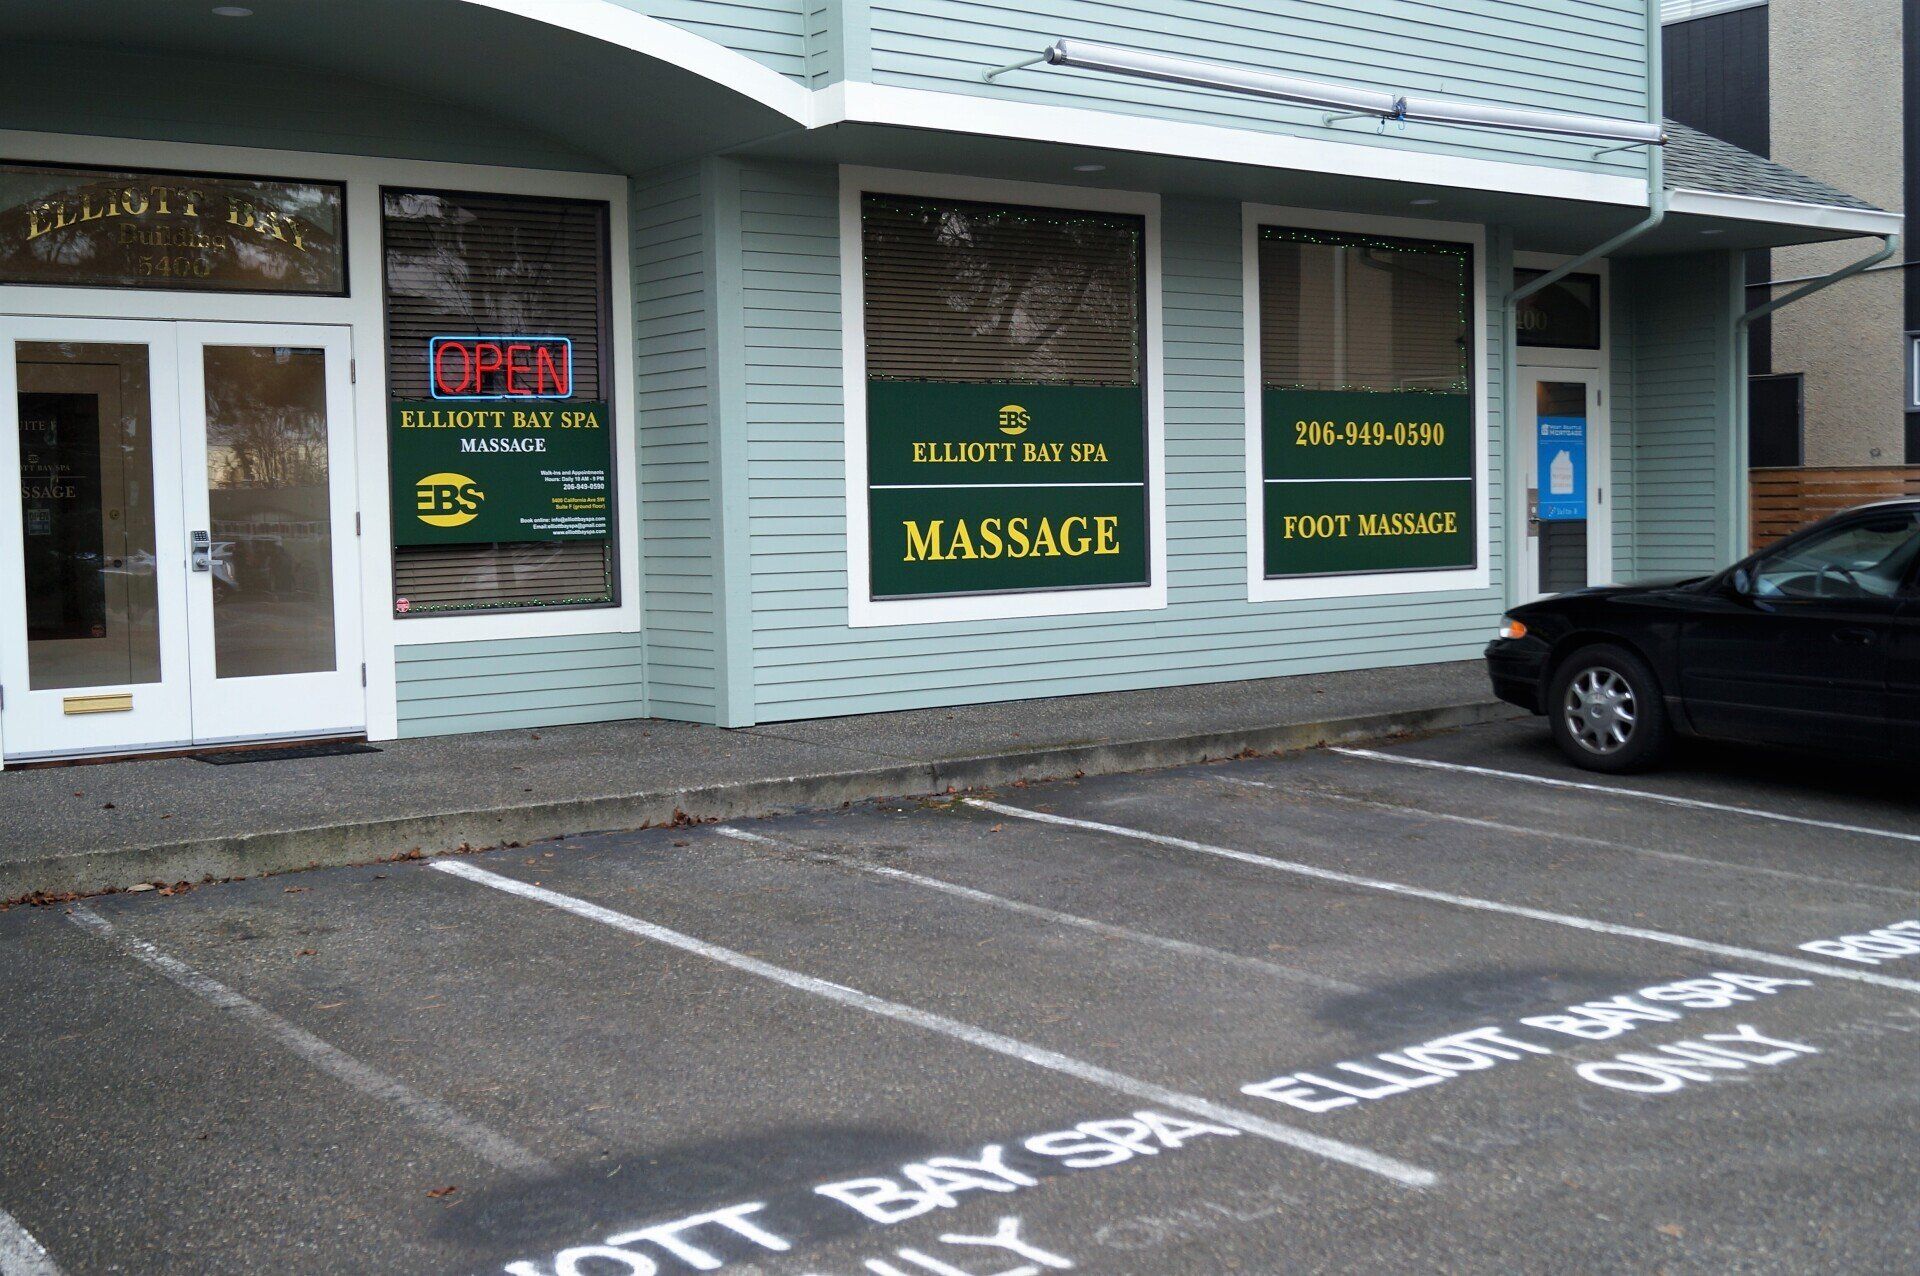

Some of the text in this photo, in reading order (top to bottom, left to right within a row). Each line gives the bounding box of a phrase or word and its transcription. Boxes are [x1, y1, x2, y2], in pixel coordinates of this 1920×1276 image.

[26, 185, 305, 252] ELLIOTT BAY
[118, 222, 226, 251] Building
[138, 255, 211, 278] 5400
[436, 341, 568, 395] OPEN
[401, 410, 599, 429] ELLIOTT BAY SPA
[998, 408, 1031, 431] EBS
[1295, 420, 1445, 447] 206-949-0590
[460, 437, 547, 453] MASSAGE
[912, 442, 1108, 463] ELLIOTT BAY SPA
[416, 481, 486, 518] EBS
[902, 516, 1120, 562] MASSAGE
[1283, 511, 1458, 539] FOOT MASSAGE
[1239, 971, 1815, 1113] ELLIOTT BAY SPA
[1575, 1023, 1820, 1093] ONLY
[504, 1110, 1243, 1276] OTT BAY SPA
